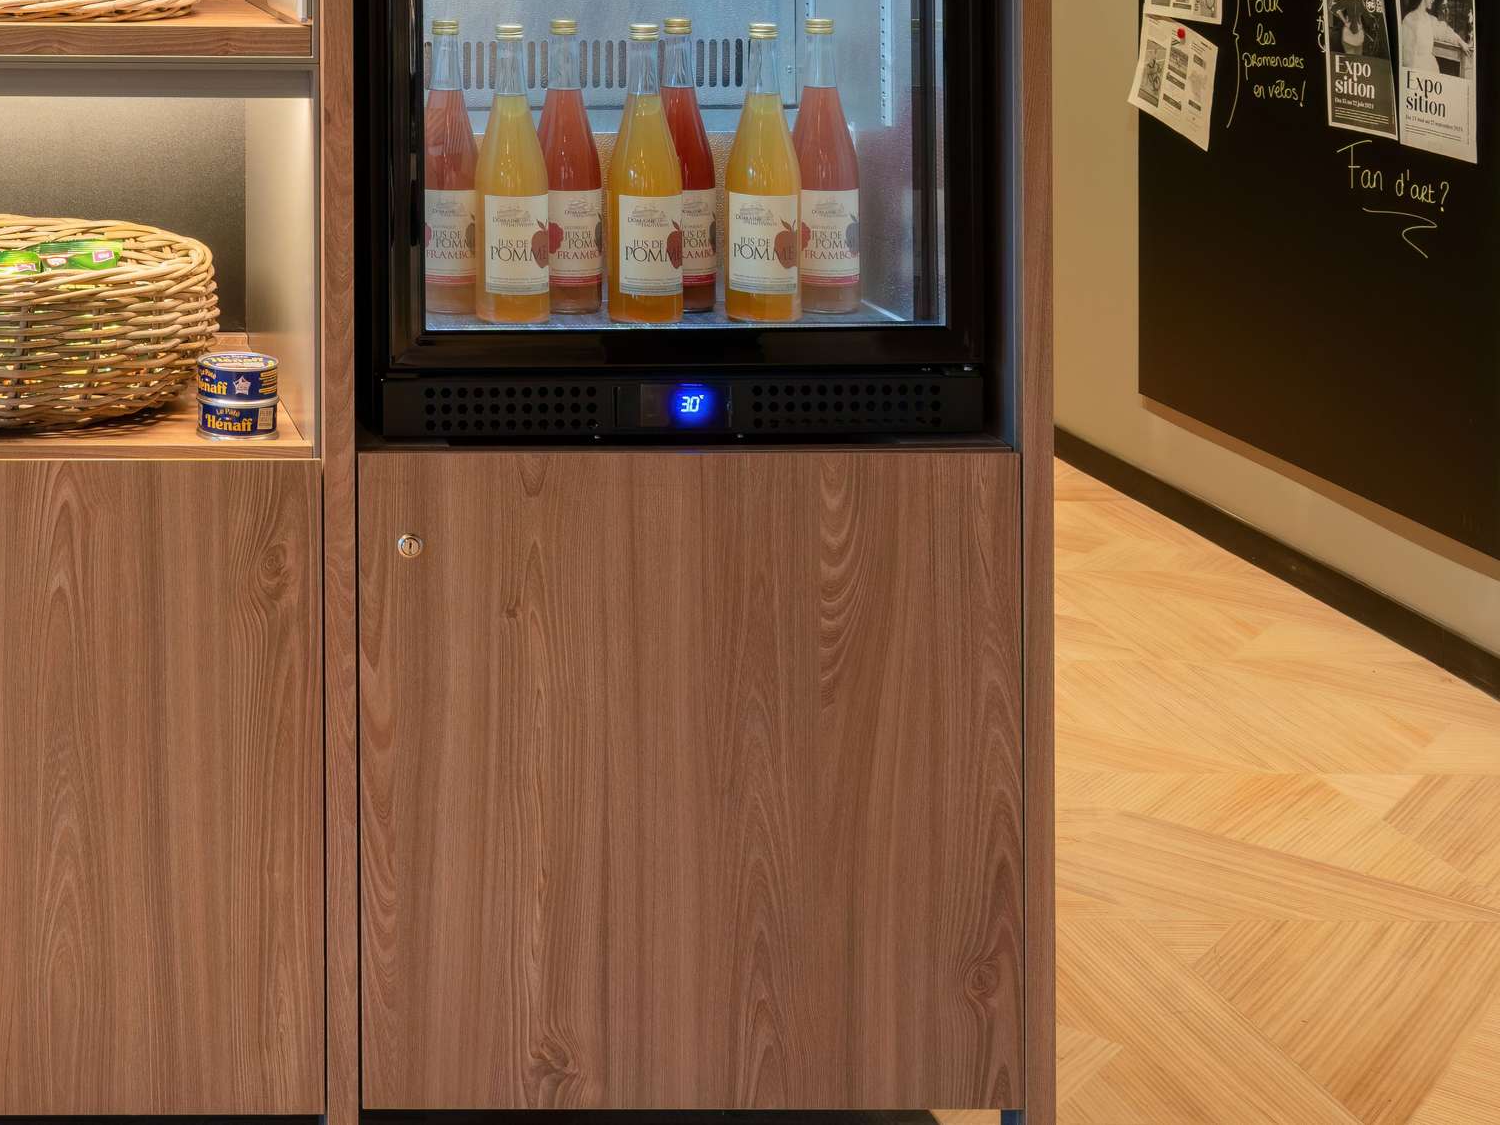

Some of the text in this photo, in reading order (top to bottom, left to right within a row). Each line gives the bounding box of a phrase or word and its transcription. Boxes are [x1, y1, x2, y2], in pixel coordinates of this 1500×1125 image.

[1256, 23, 1276, 46] les
[1242, 52, 1305, 81] promenades
[1335, 54, 1371, 81] Expo
[1335, 76, 1375, 100] sition
[1406, 70, 1443, 96] Expo
[1253, 82, 1267, 100] en
[1406, 94, 1446, 117] sition
[1337, 139, 1383, 190] Fan
[432, 230, 449, 240] JUS
[564, 230, 581, 240] JUS
[811, 231, 842, 240] JUS DE
[435, 238, 475, 249] POMM
[497, 238, 529, 249] JUS DE
[568, 238, 600, 249] POMM
[633, 238, 664, 249] JUS DE
[740, 237, 770, 247] JUS DE
[815, 238, 852, 249] POMM
[426, 250, 475, 260] FRAMBO
[557, 250, 600, 259] FRAMBO
[205, 414, 253, 432] Hénaff
